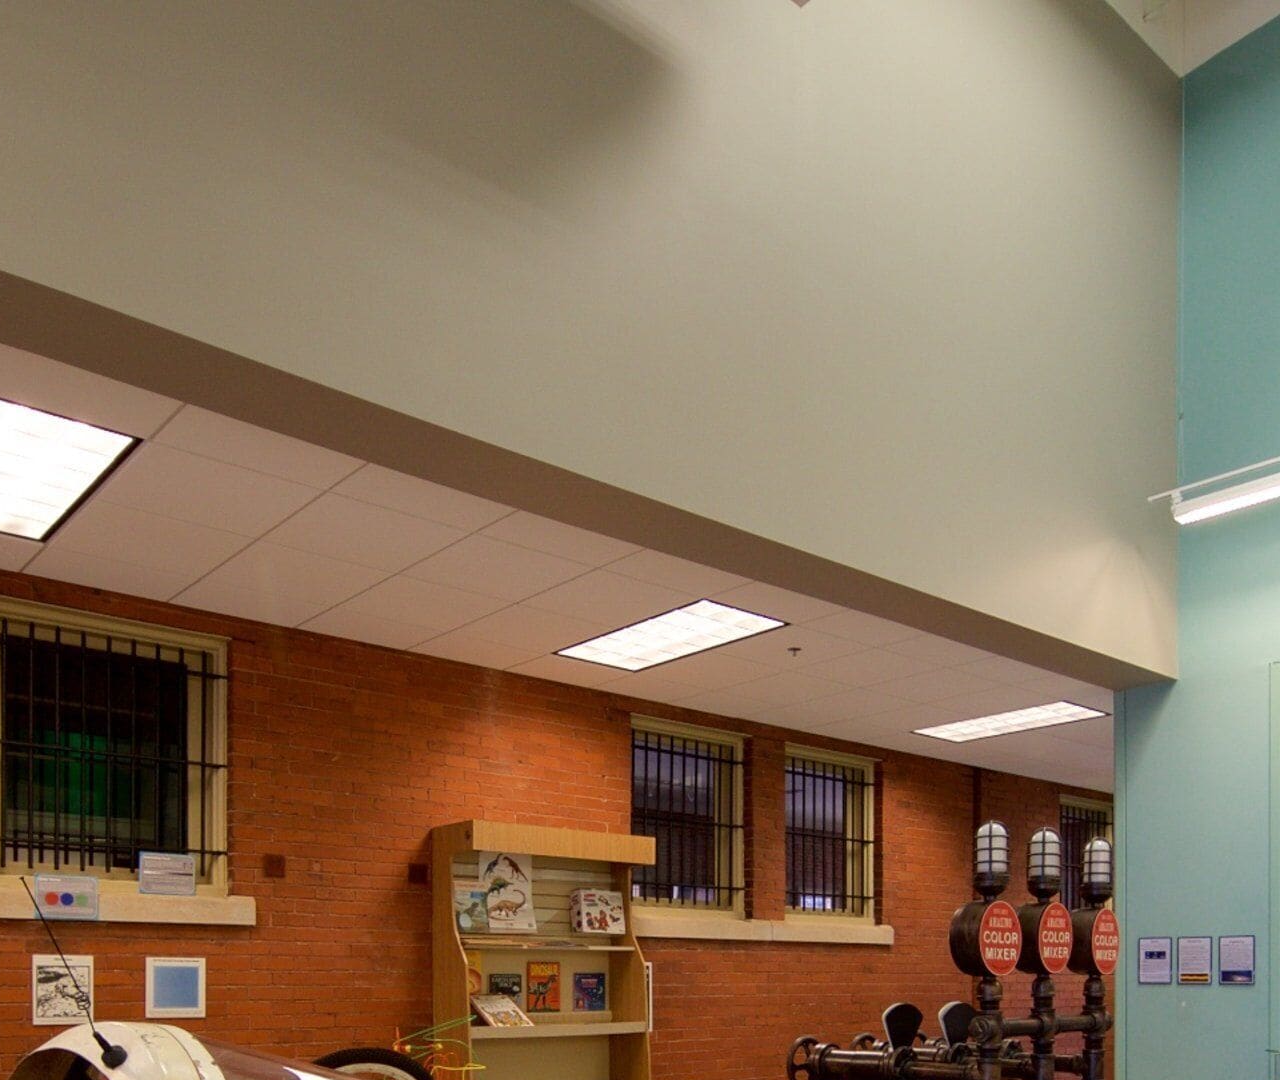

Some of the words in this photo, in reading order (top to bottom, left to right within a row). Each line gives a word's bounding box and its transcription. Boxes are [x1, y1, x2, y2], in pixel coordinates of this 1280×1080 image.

[983, 930, 1018, 945] COLOR
[1042, 930, 1070, 944] COLOR
[1094, 934, 1119, 947] COLOR
[985, 946, 1017, 961] MIXER
[1043, 946, 1069, 959] MIXER
[1095, 949, 1117, 961] MIXER
